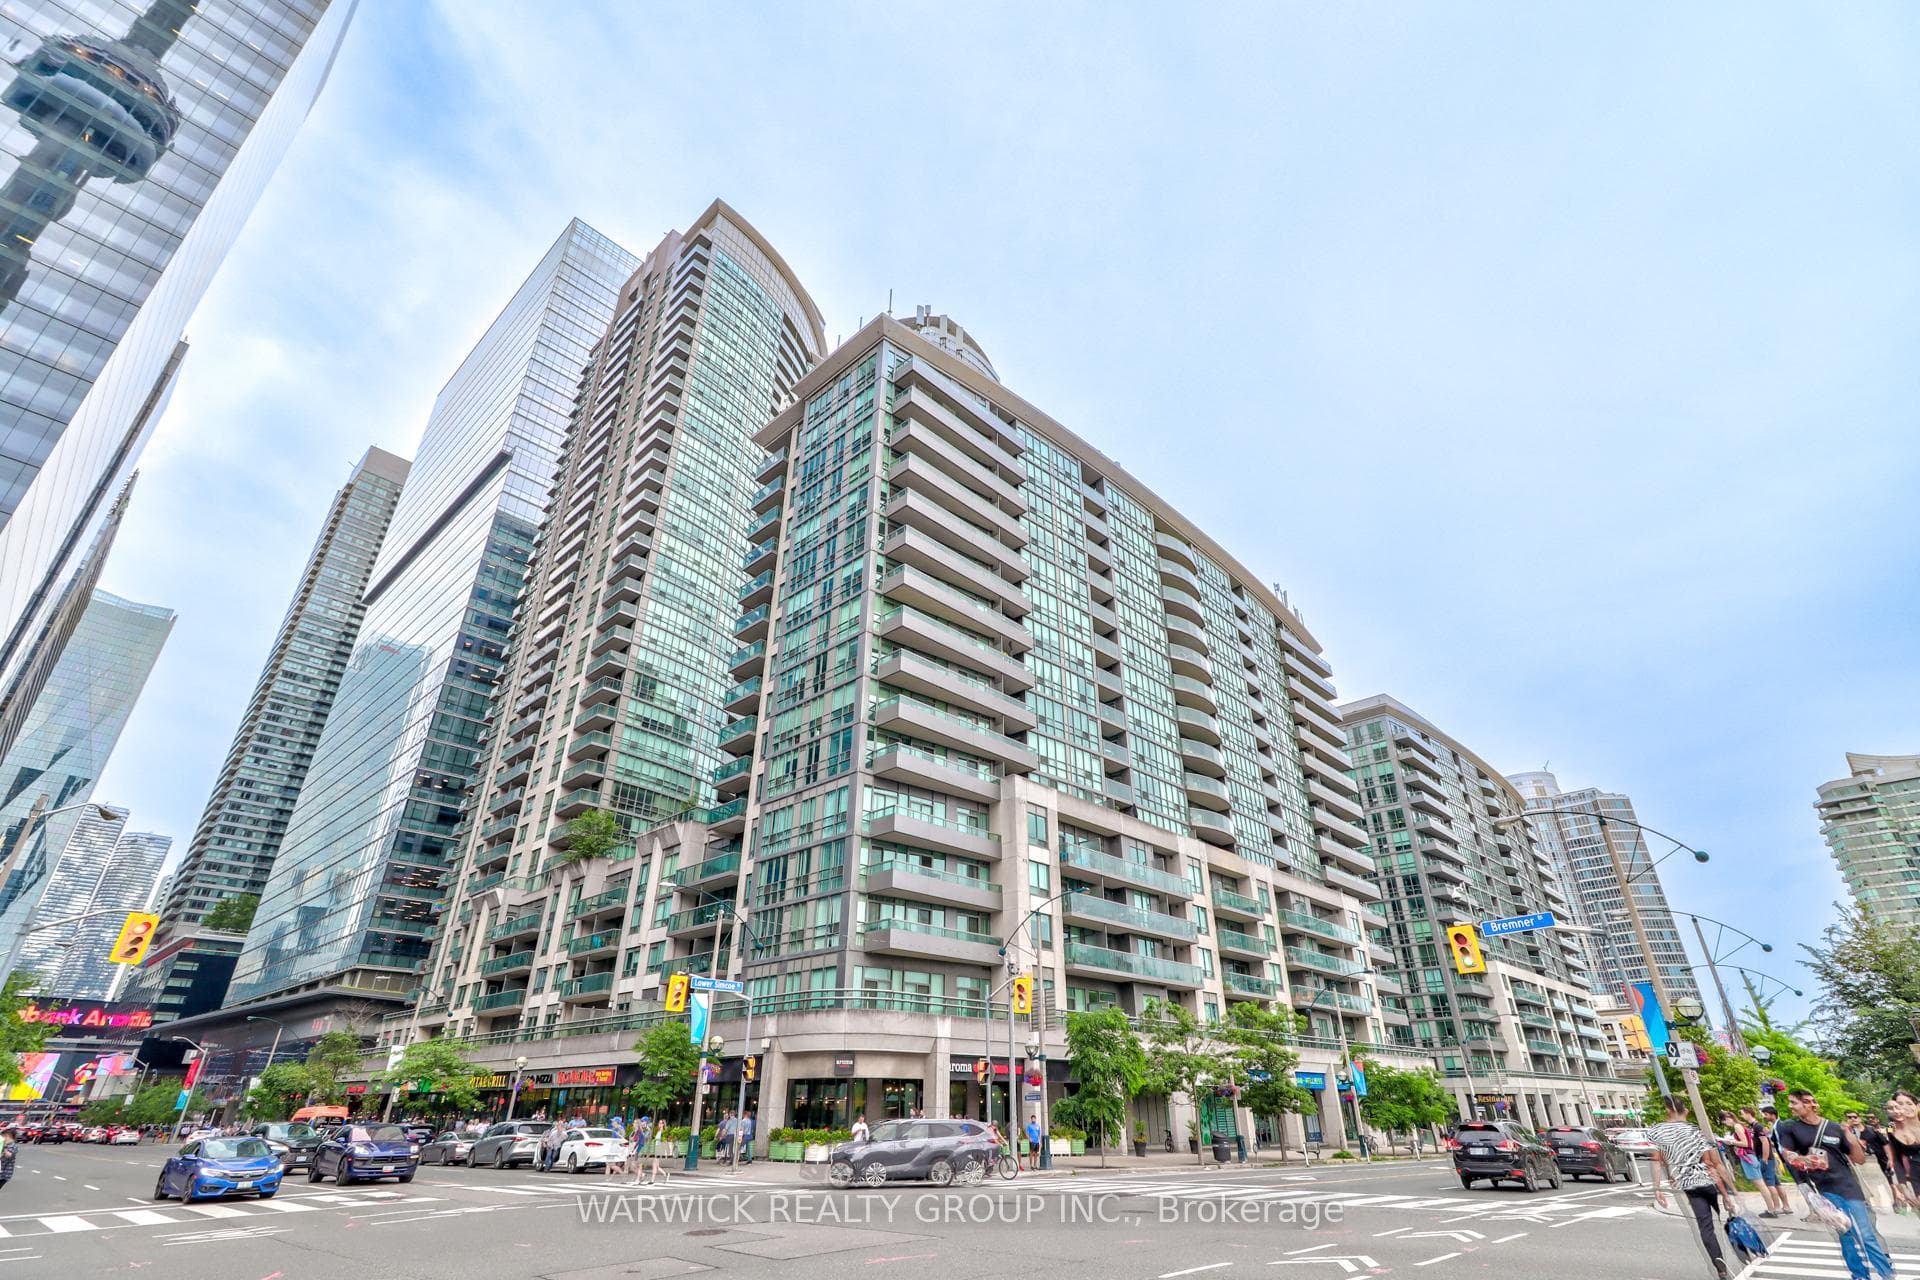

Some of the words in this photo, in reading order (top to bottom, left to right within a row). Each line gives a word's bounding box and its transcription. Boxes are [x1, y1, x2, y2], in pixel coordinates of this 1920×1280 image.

[1490, 918, 1535, 932] Bremner
[694, 979, 713, 988] Lower
[714, 981, 736, 990] Simcoe
